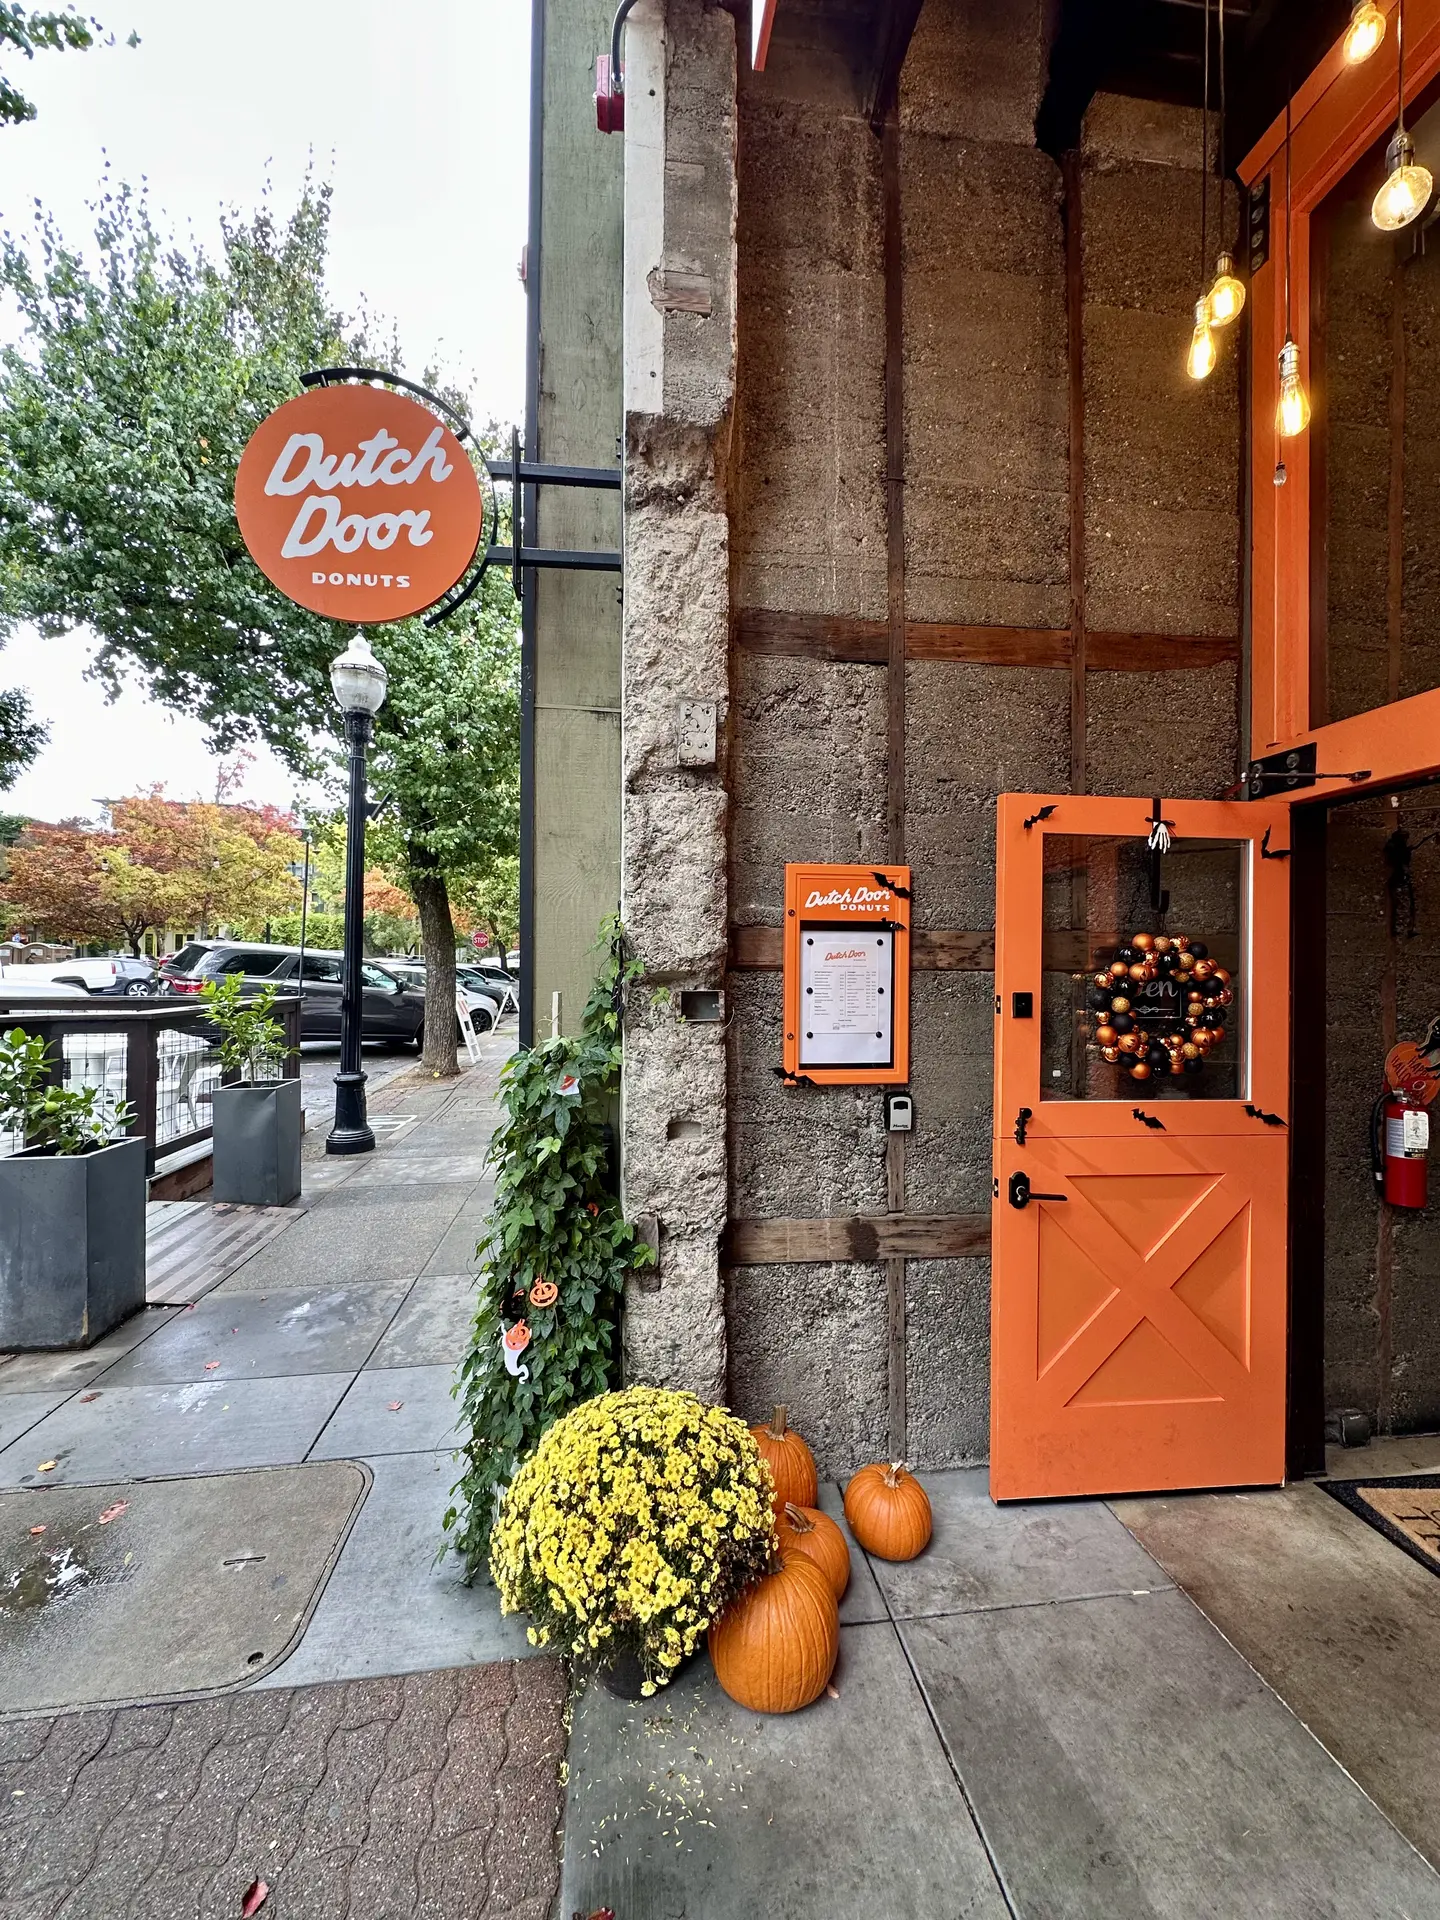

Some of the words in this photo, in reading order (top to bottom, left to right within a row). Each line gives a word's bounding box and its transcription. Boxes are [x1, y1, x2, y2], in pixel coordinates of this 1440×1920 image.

[264, 426, 453, 496] Dutch
[280, 495, 433, 558] Door
[312, 572, 410, 588] DONUTS
[804, 887, 853, 908] Dutch
[852, 886, 891, 903] Door
[840, 904, 890, 912] DONUTS
[824, 951, 848, 961] Dutch
[848, 950, 866, 959] Door
[1139, 980, 1179, 998] en
